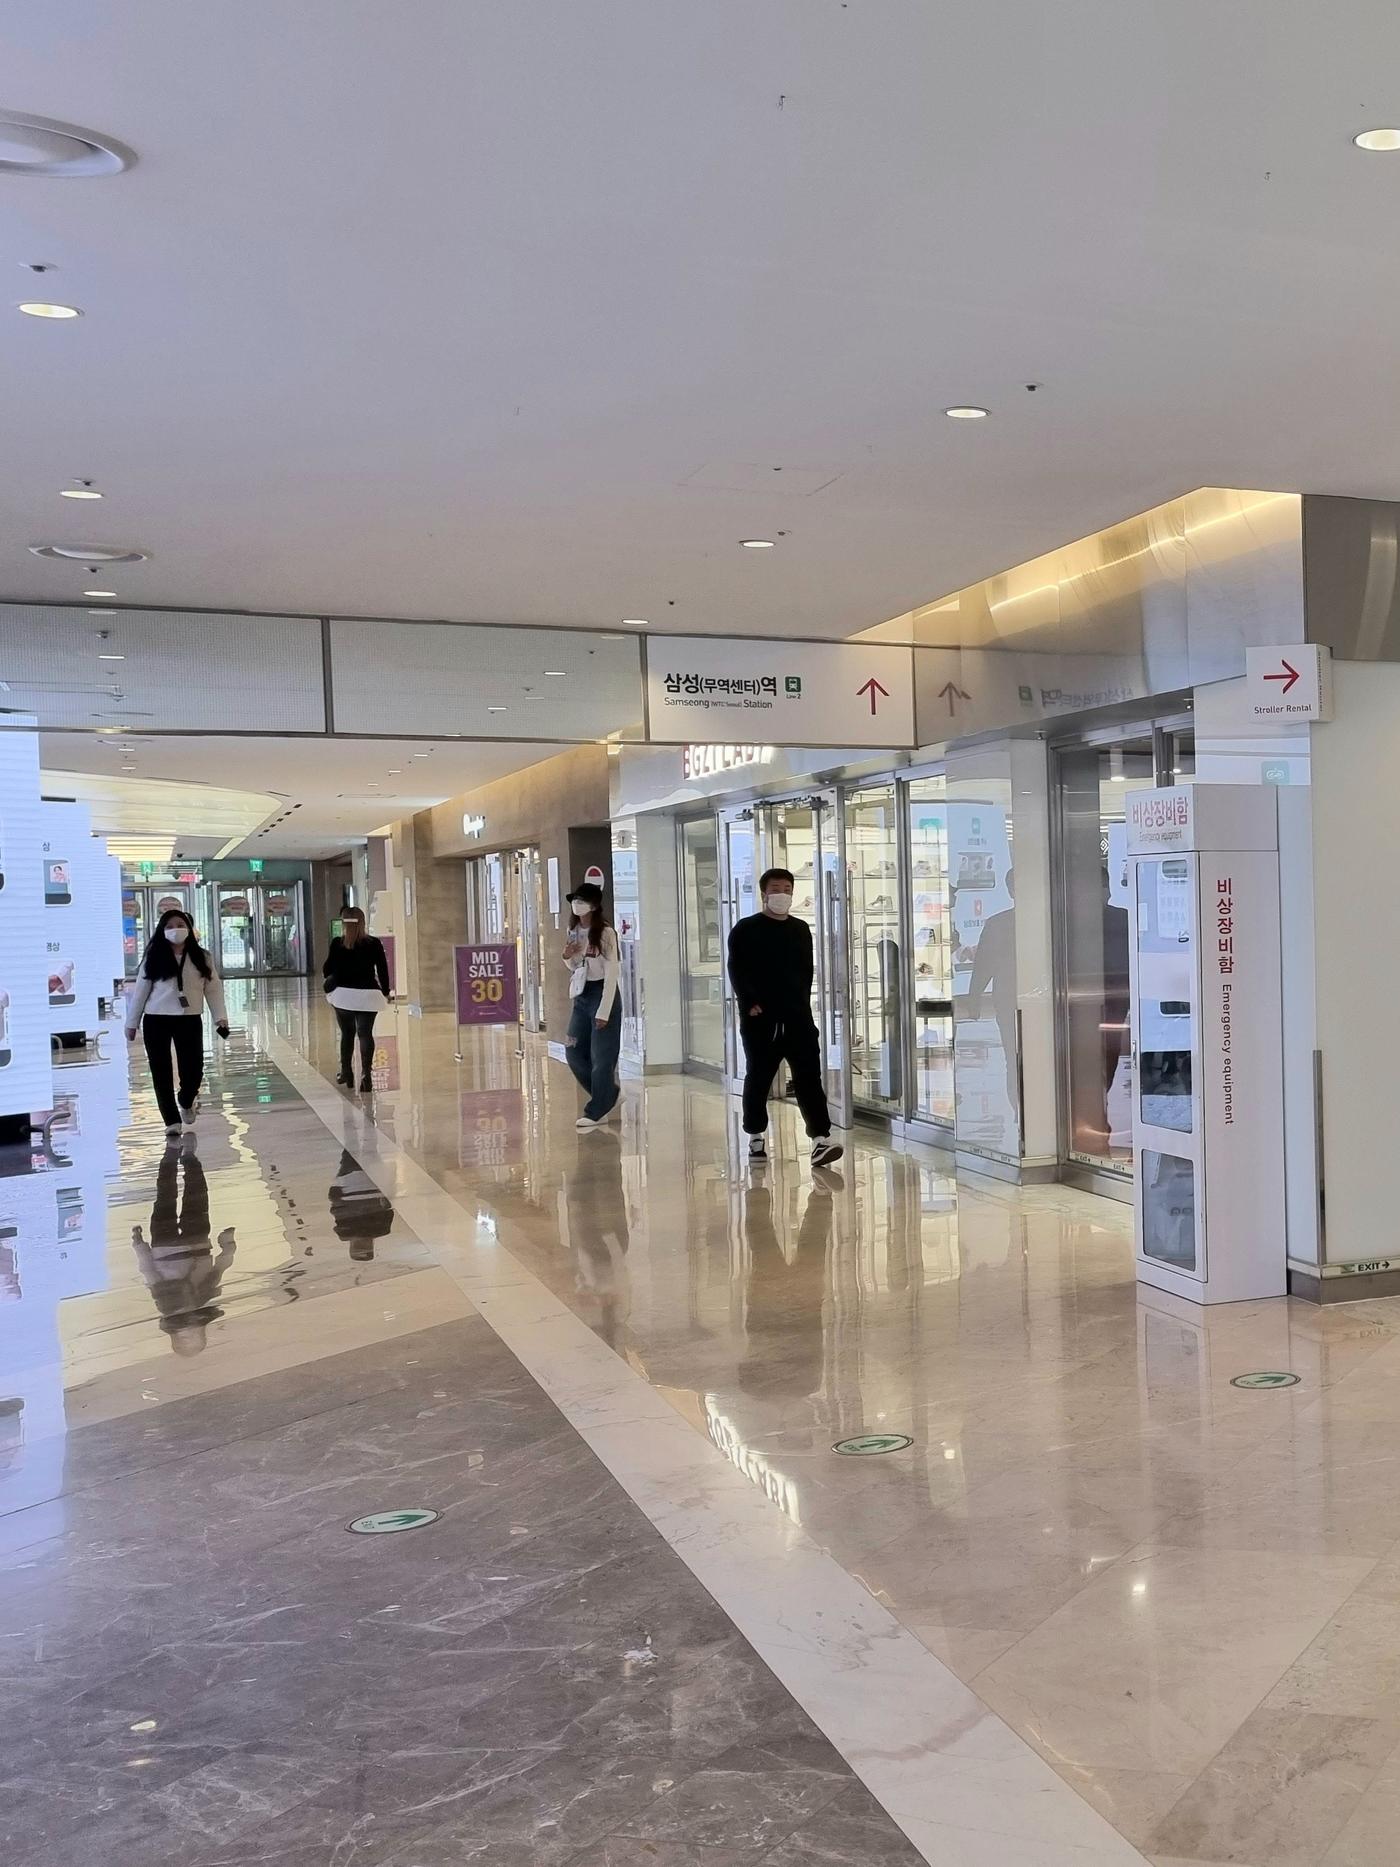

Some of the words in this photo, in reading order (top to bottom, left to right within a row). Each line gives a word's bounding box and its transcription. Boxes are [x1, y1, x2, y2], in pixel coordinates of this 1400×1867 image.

[663, 673, 777, 696] 삼성(무역센터)역
[664, 697, 710, 709] Samseong
[743, 699, 773, 709] Station
[1254, 705, 1284, 714] Stroller
[1286, 704, 1312, 712] Rental
[1132, 796, 1189, 828] 비상장비함
[1217, 878, 1233, 974] 비상장비함
[471, 951, 499, 965] MID
[469, 964, 504, 978] SALE
[471, 978, 503, 1003] 30
[1221, 984, 1232, 1054] Emergency
[1222, 1058, 1234, 1125] equipment
[1358, 1261, 1381, 1273] EXIT
